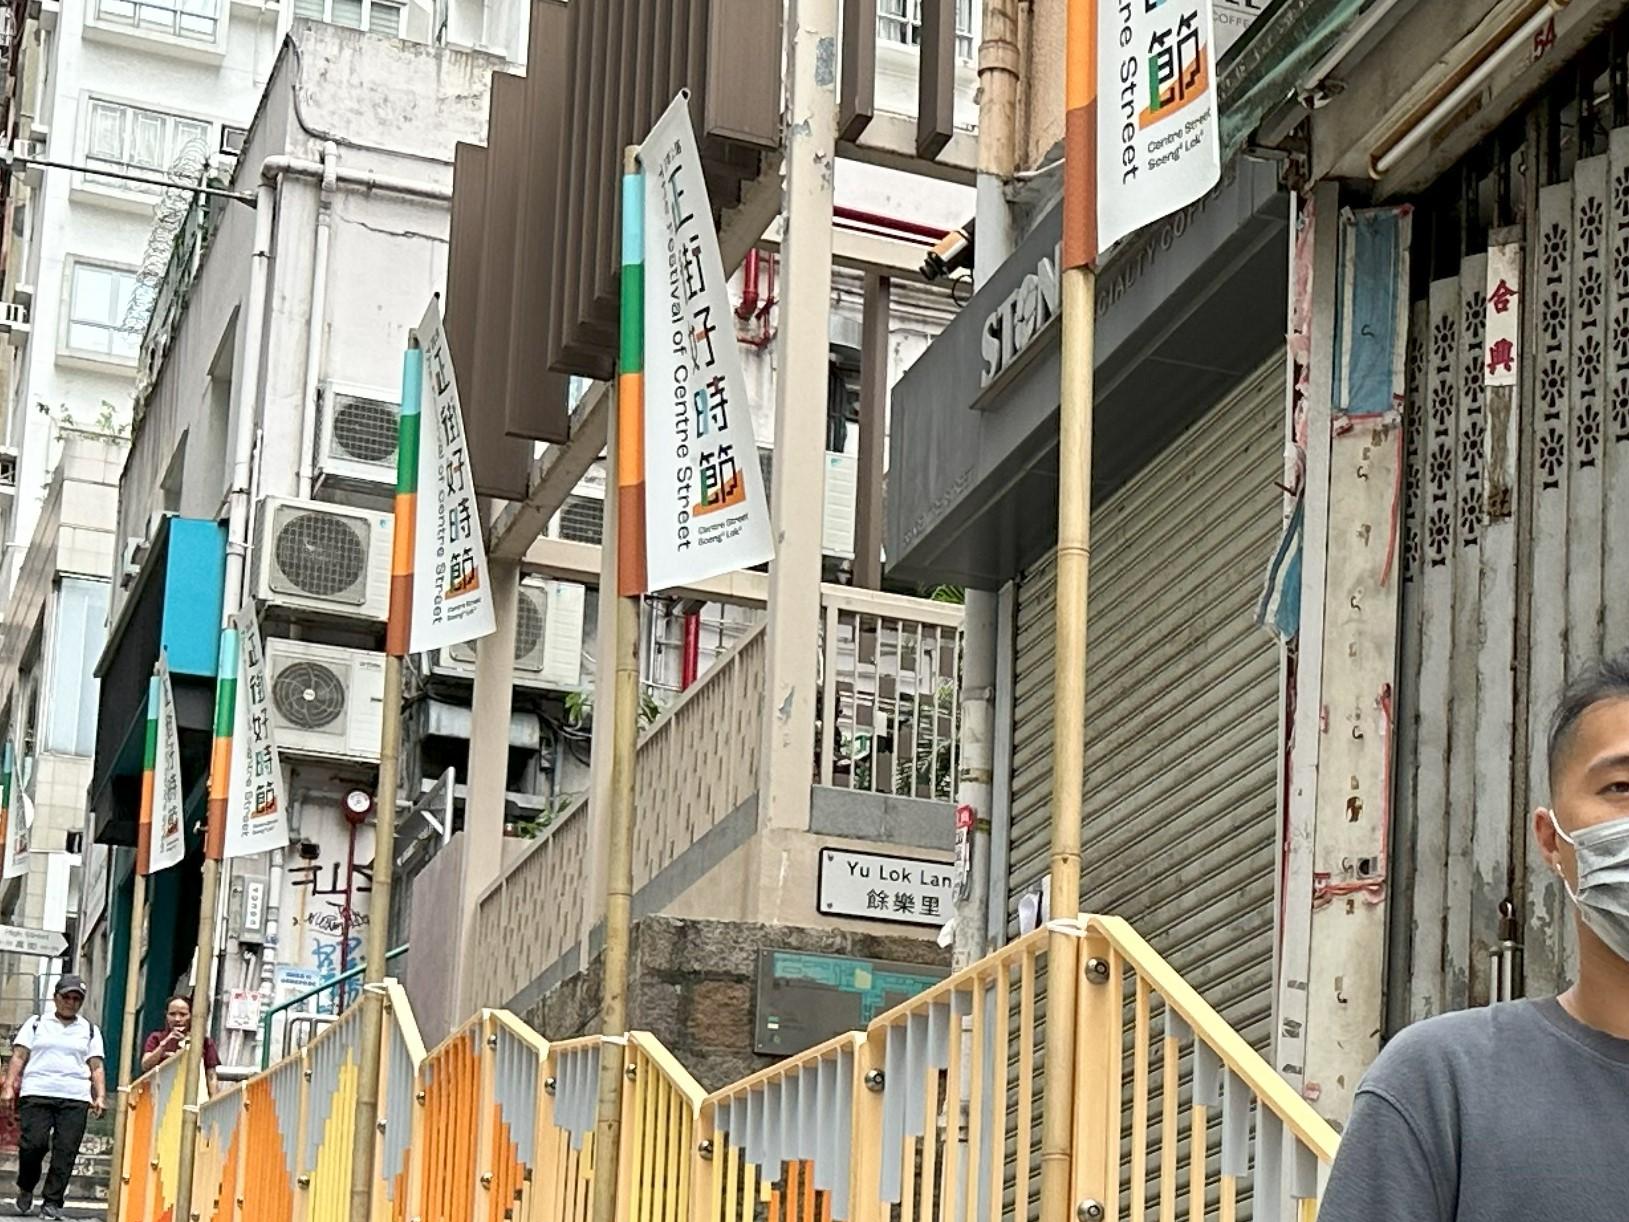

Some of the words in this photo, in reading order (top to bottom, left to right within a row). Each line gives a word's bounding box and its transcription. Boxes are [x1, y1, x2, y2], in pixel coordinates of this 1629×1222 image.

[1120, 56, 1139, 185] Street
[672, 330, 687, 354] of
[674, 365, 690, 459] Centre
[677, 465, 693, 552] Street
[847, 861, 870, 878] Yu
[880, 865, 912, 884] Lok
[920, 870, 952, 888] Lan
[866, 888, 941, 917] 餘樂里
